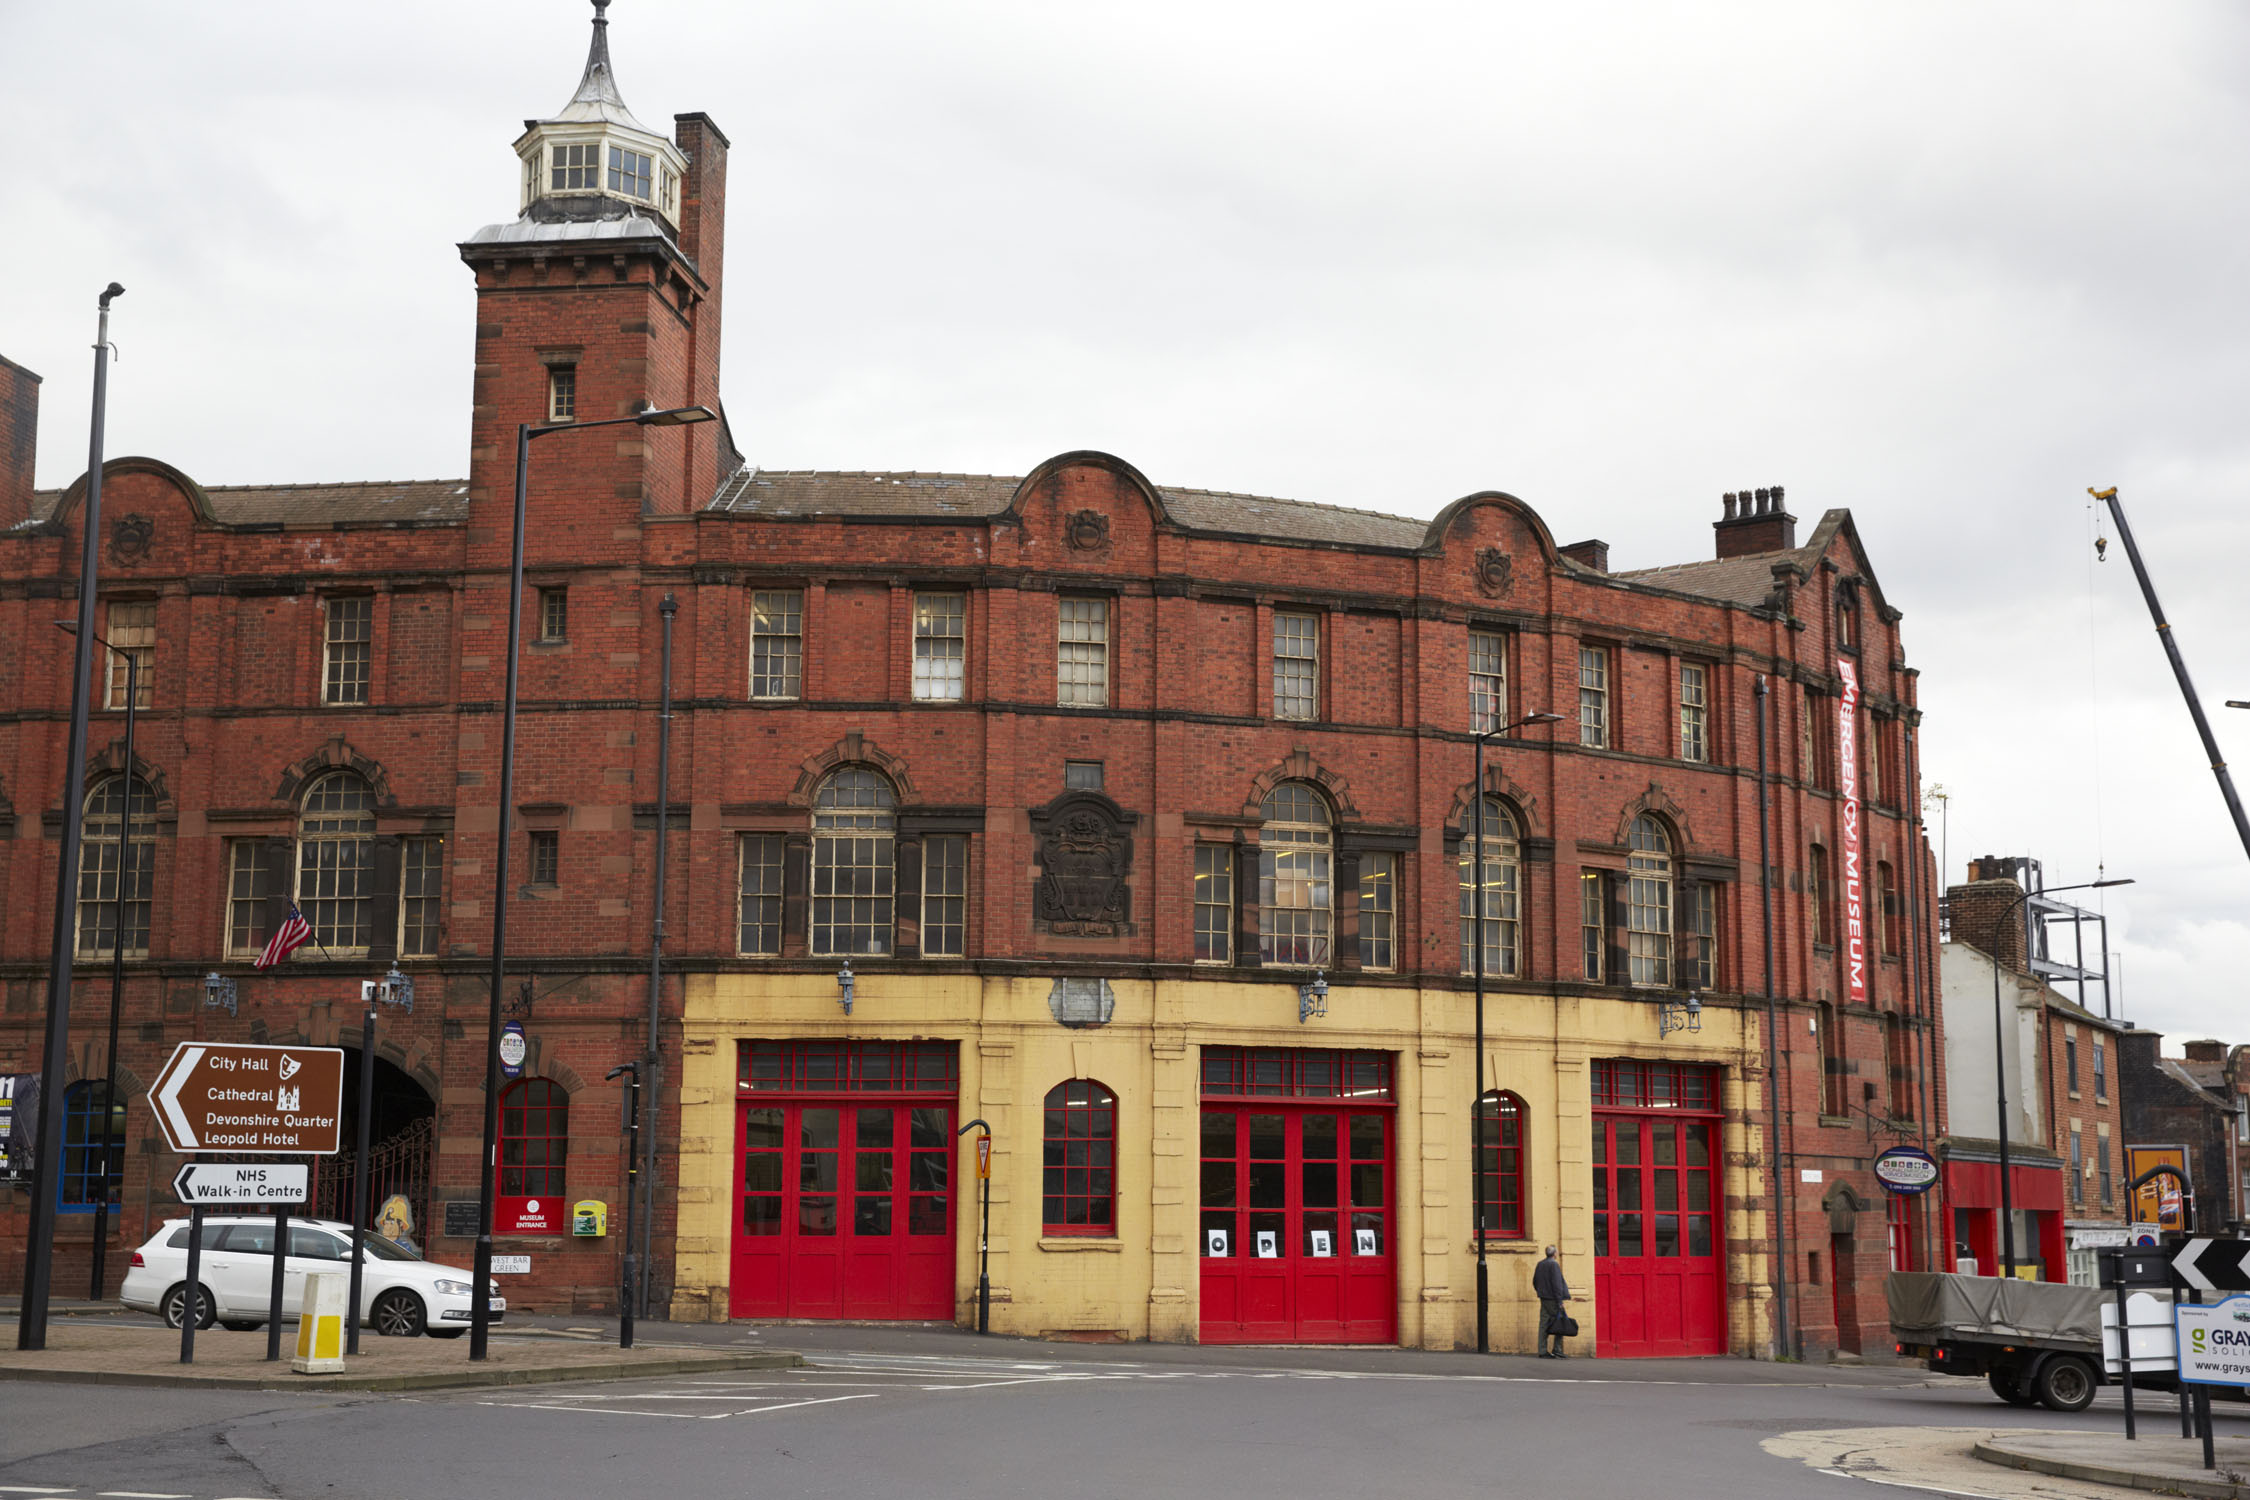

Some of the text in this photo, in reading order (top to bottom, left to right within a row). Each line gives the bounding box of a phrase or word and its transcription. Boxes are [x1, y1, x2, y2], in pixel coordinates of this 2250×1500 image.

[1838, 659, 1863, 988] EMERGENCY MUSEUM
[209, 1056, 269, 1071] City Hall
[207, 1088, 273, 1101] Cathedral
[206, 1112, 334, 1127] Devonshire Quarter
[205, 1132, 299, 1146] Leopold Hotel
[236, 1170, 267, 1182] NHS
[197, 1185, 303, 1197] Walk-in Centre
[491, 1256, 509, 1264] WEST
[494, 1264, 520, 1272] GREEN
[2212, 1346, 2250, 1356] SOLI
